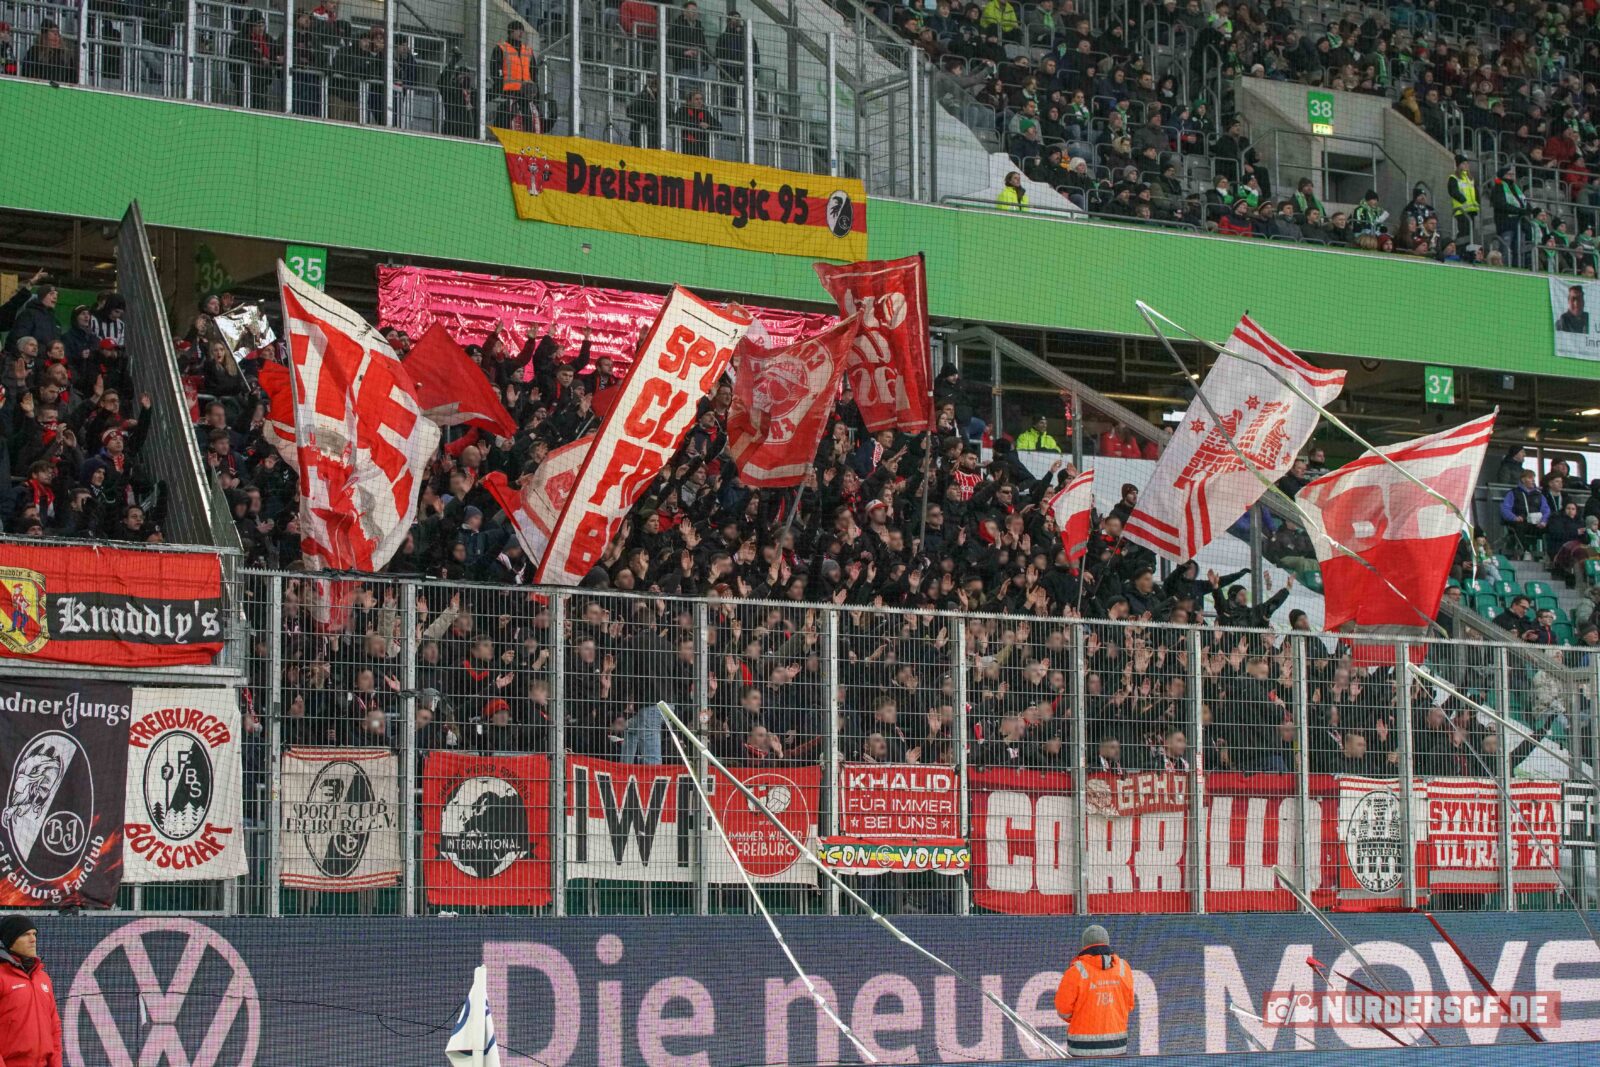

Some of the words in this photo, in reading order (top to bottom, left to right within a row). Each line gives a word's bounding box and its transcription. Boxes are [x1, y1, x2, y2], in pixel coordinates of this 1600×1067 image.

[1310, 99, 1332, 118] 38
[566, 151, 686, 209] Dreisam
[692, 171, 770, 228] Magic
[778, 184, 809, 226] 95
[290, 256, 322, 281] 35
[1428, 375, 1452, 395] 37
[57, 596, 220, 644] Knaddly's
[128, 708, 231, 748] FREIBURGER
[849, 773, 951, 793] KHALID
[849, 794, 886, 812] FÜR
[892, 799, 952, 813] IMMER
[864, 817, 892, 829] BEI
[898, 817, 938, 830] UNS
[124, 823, 233, 870] BOTSCHAFT
[447, 839, 521, 850] INTERNATIONAL
[737, 842, 796, 857] FREIBURG
[826, 846, 871, 867] CON
[899, 847, 968, 869] VOLTS
[1, 853, 61, 904] Freiburg
[63, 835, 104, 895] Fanclub
[481, 934, 716, 1067] Die
